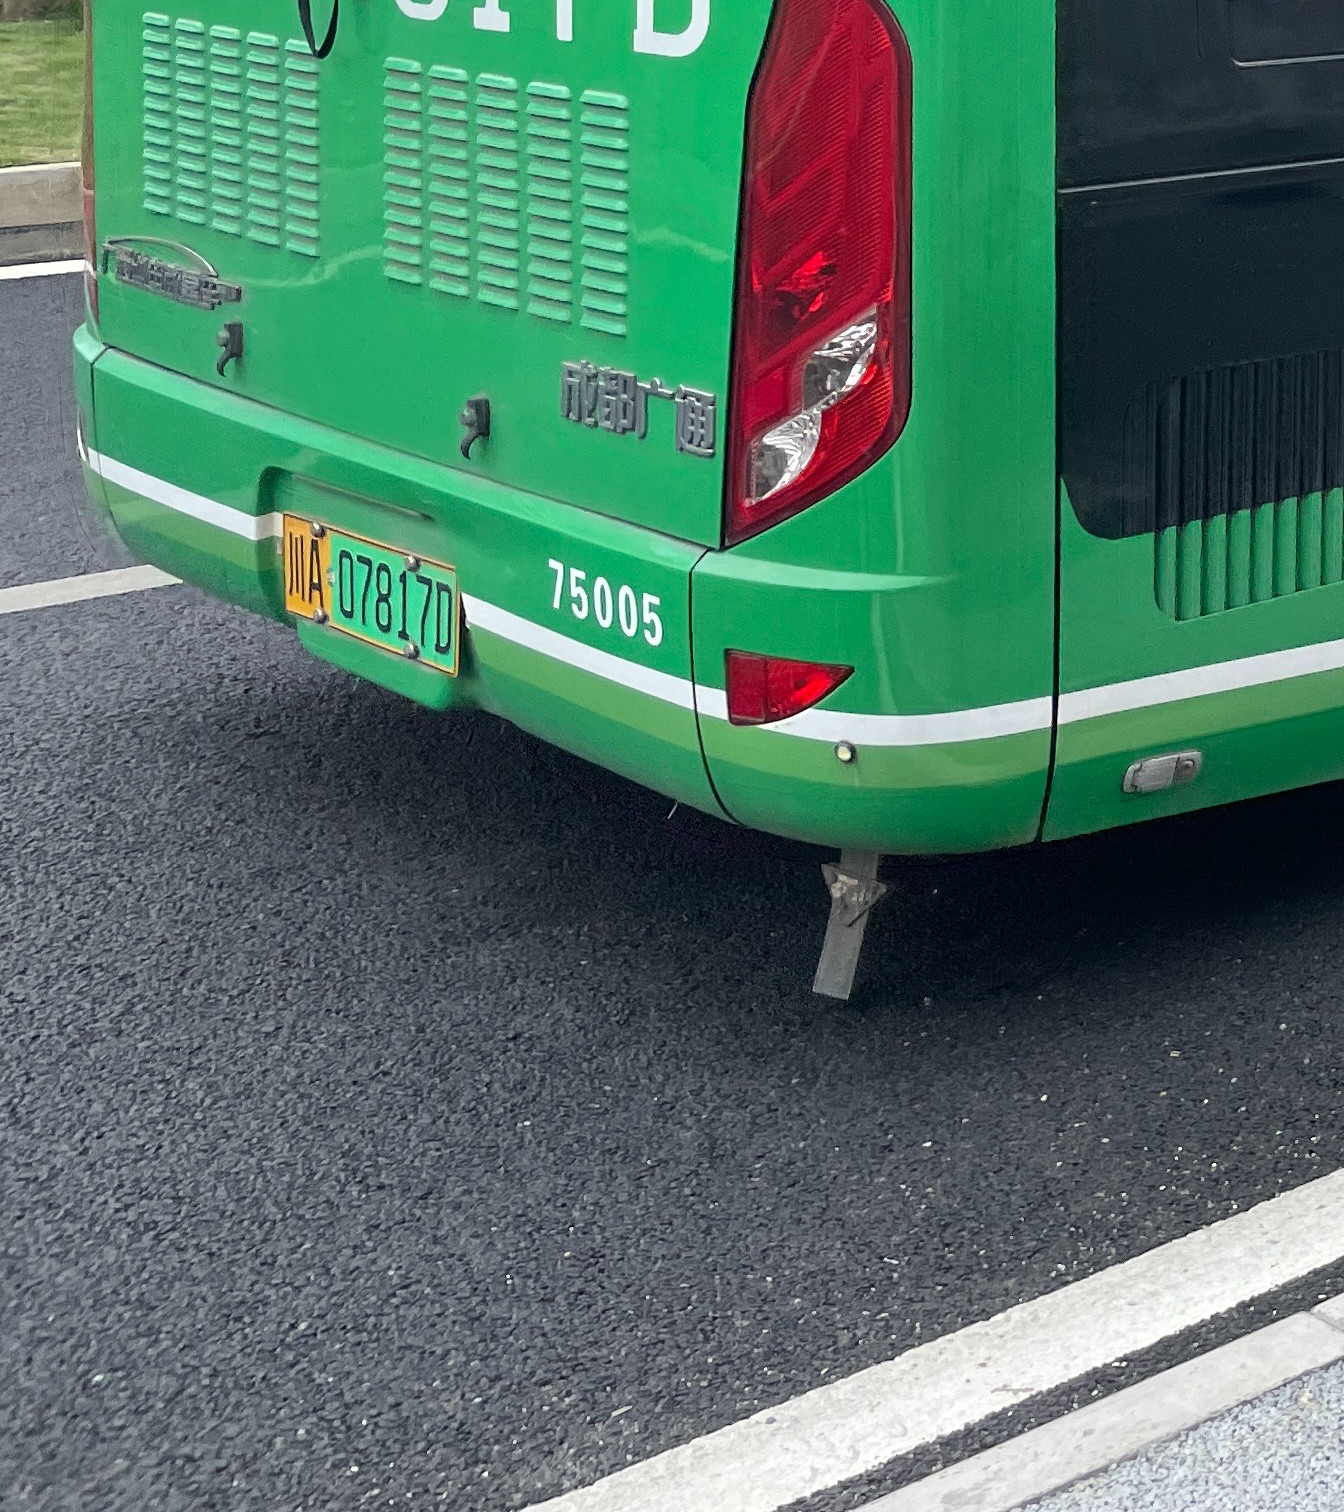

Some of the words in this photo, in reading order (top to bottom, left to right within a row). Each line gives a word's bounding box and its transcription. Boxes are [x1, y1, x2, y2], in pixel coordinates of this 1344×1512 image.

[561, 360, 717, 458] 成都广通
[548, 558, 664, 647] 75005
